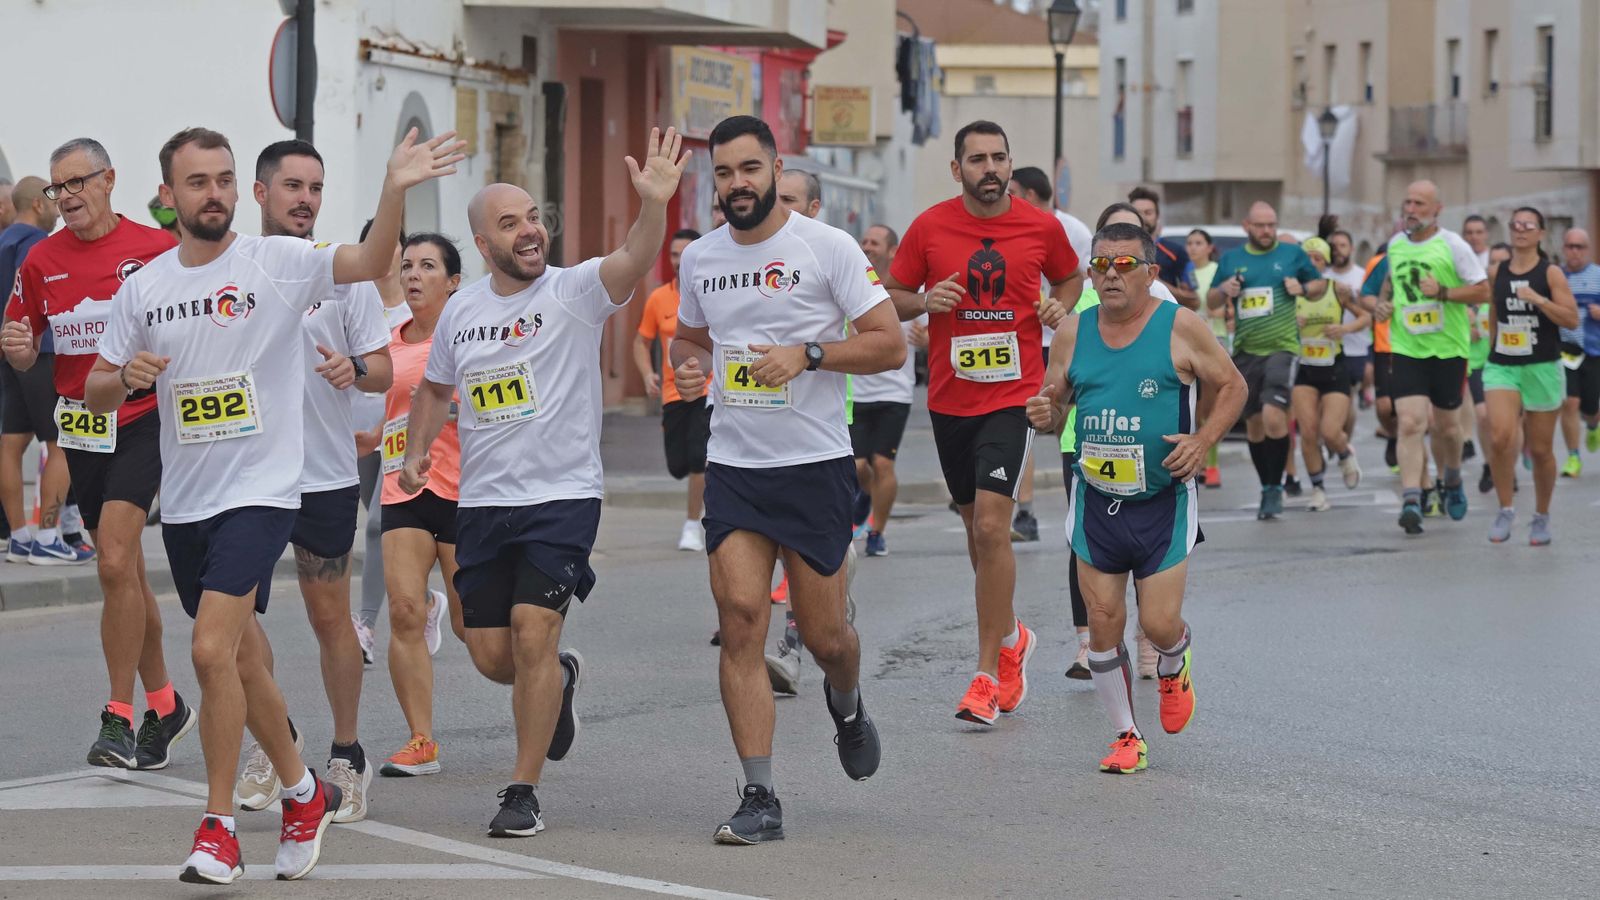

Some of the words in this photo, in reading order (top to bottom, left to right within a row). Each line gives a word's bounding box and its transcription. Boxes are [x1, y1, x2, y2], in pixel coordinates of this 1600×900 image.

[1241, 296, 1266, 309] 217
[1412, 312, 1432, 323] 41
[54, 323, 81, 338] SAN
[85, 321, 108, 335] RO
[71, 336, 101, 350] RUNN
[960, 347, 1011, 368] 315
[471, 379, 524, 408] 111
[181, 392, 246, 422] 292
[60, 412, 107, 434] 248
[1083, 408, 1141, 436] mijas
[385, 431, 406, 456] 16
[1100, 460, 1117, 479] 4
